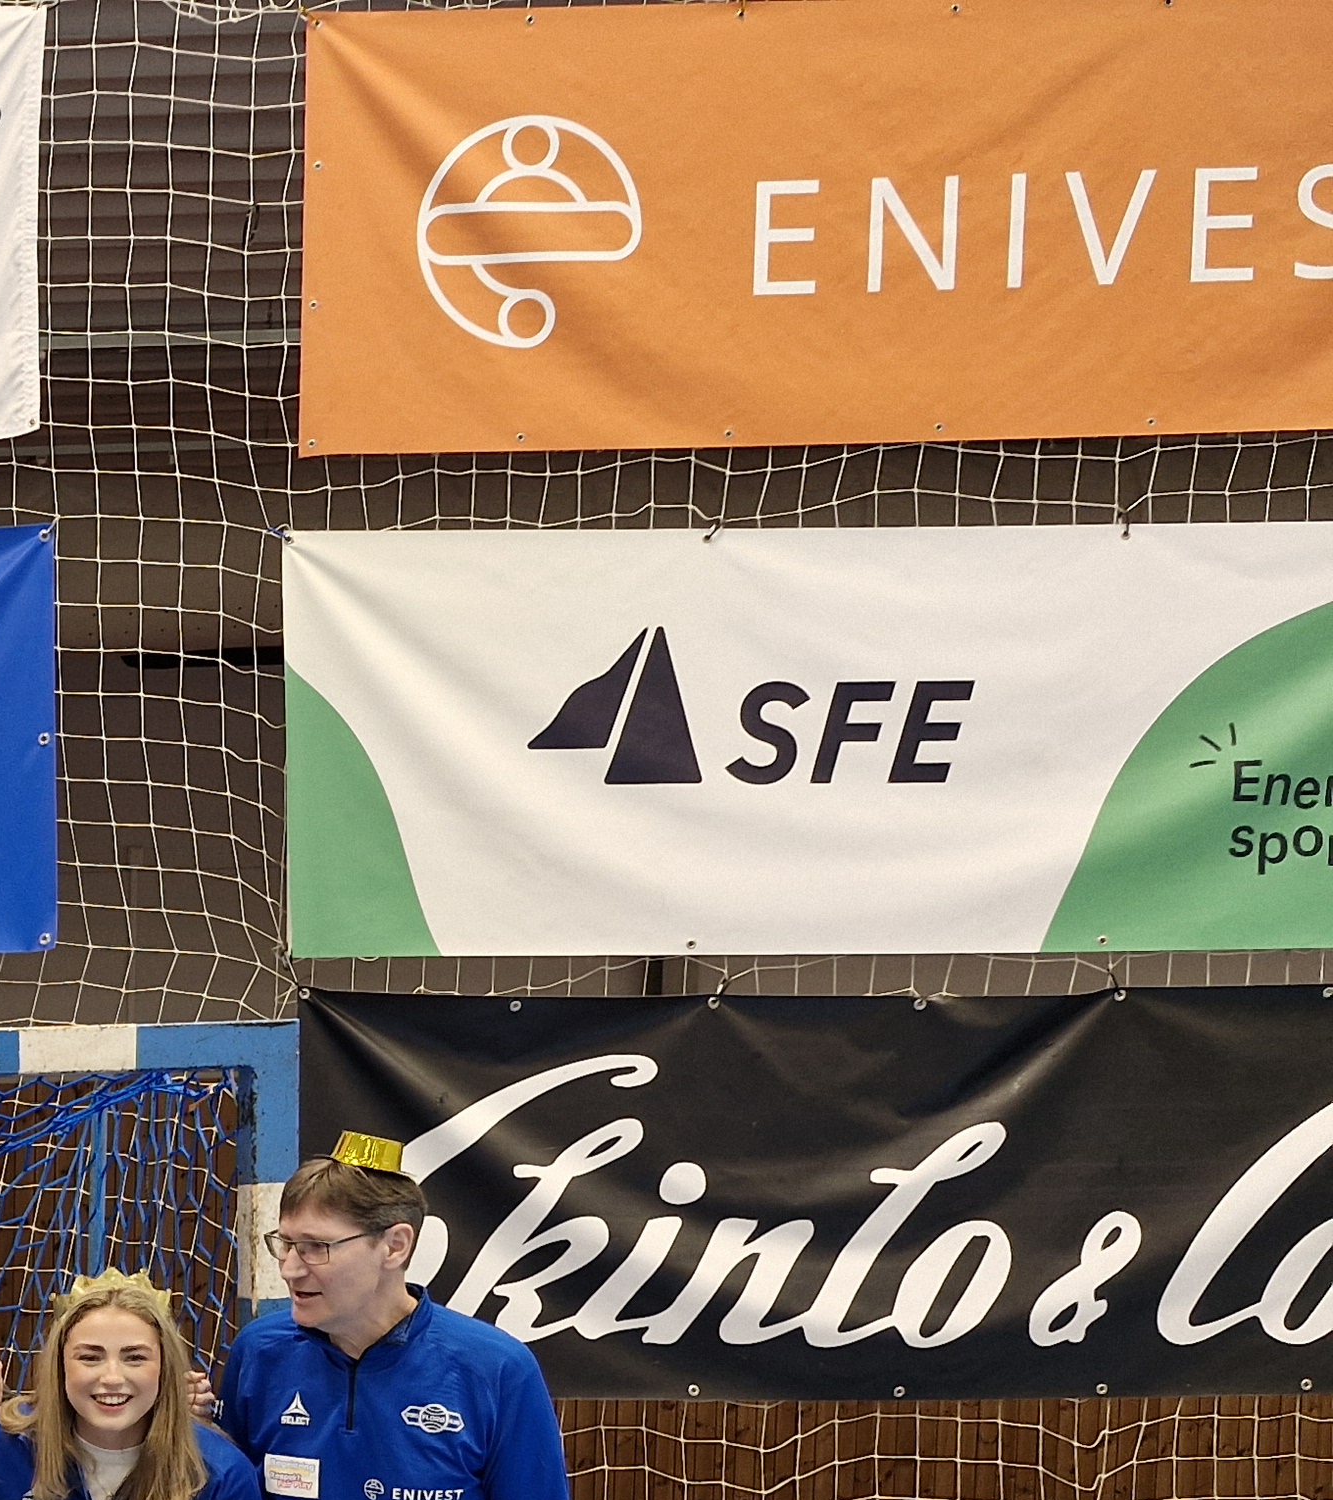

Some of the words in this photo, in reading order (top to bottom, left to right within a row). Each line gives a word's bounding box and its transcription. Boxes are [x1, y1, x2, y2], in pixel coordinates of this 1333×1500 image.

[724, 679, 974, 785] SFE
[1228, 825, 1333, 875] spo
[1028, 1210, 1141, 1347] &
[281, 1416, 309, 1425] SELECT
